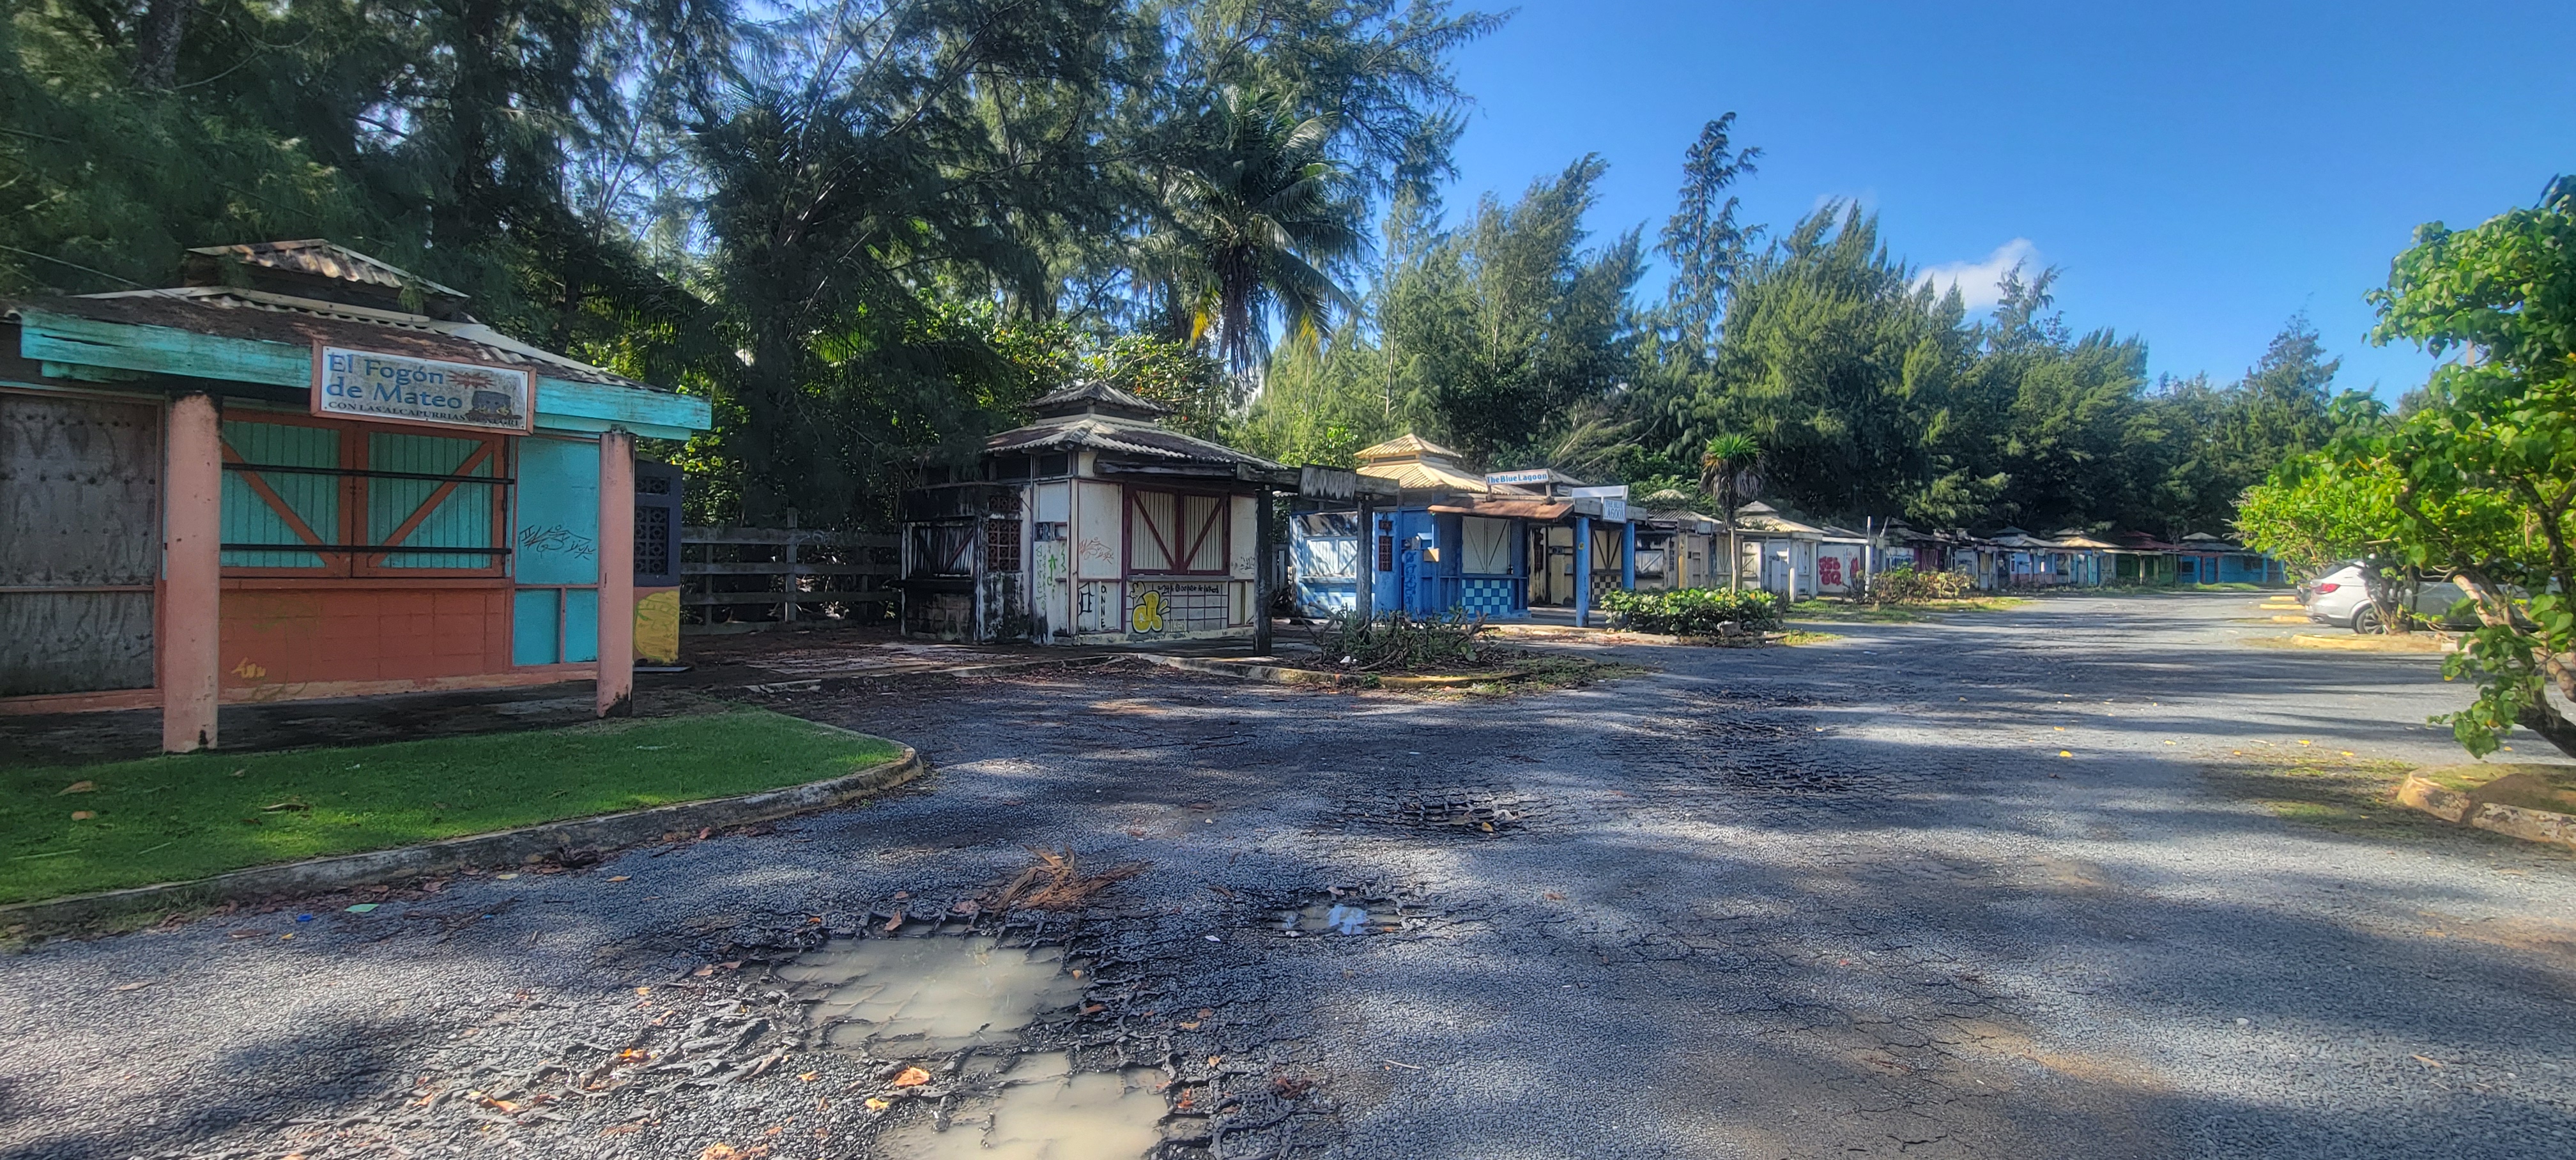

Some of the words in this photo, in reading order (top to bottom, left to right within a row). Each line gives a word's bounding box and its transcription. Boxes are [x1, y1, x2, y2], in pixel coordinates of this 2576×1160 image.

[328, 353, 353, 373] El
[364, 359, 443, 385] Fogón
[326, 376, 362, 398] de
[373, 383, 463, 409] Mateo
[328, 401, 356, 410] CON
[383, 407, 466, 421] ALCAPURRIAS
[1518, 473, 1547, 482] Lagoon
[1604, 507, 1624, 520] LAGOON
